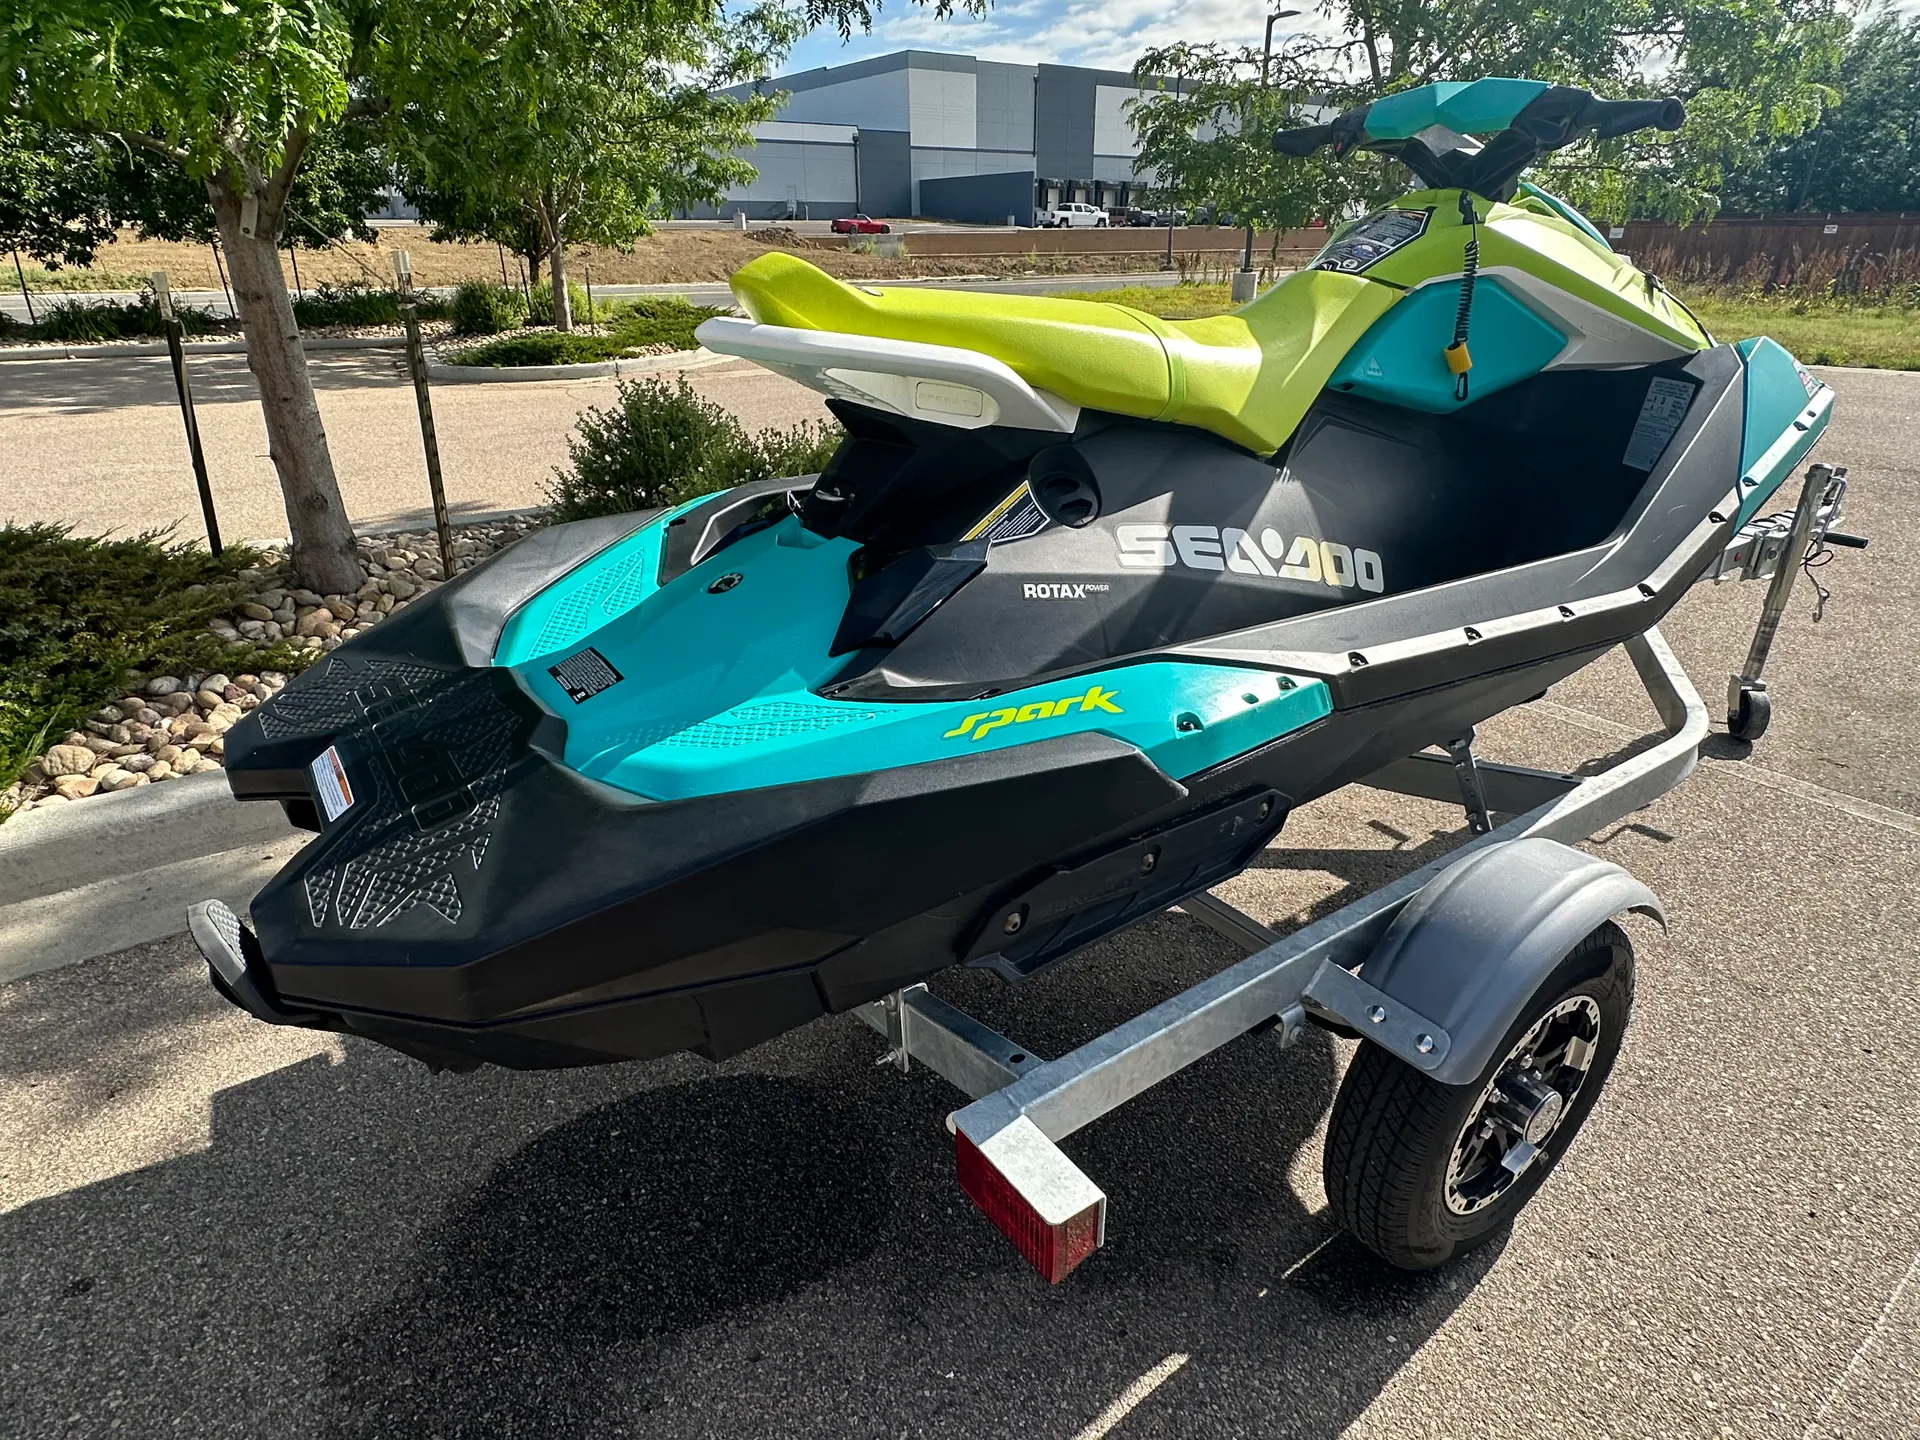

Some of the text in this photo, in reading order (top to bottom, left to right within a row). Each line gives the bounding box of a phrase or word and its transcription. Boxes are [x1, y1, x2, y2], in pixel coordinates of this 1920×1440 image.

[1023, 583, 1110, 599] ROTAX POWER
[942, 686, 1125, 741] spark
